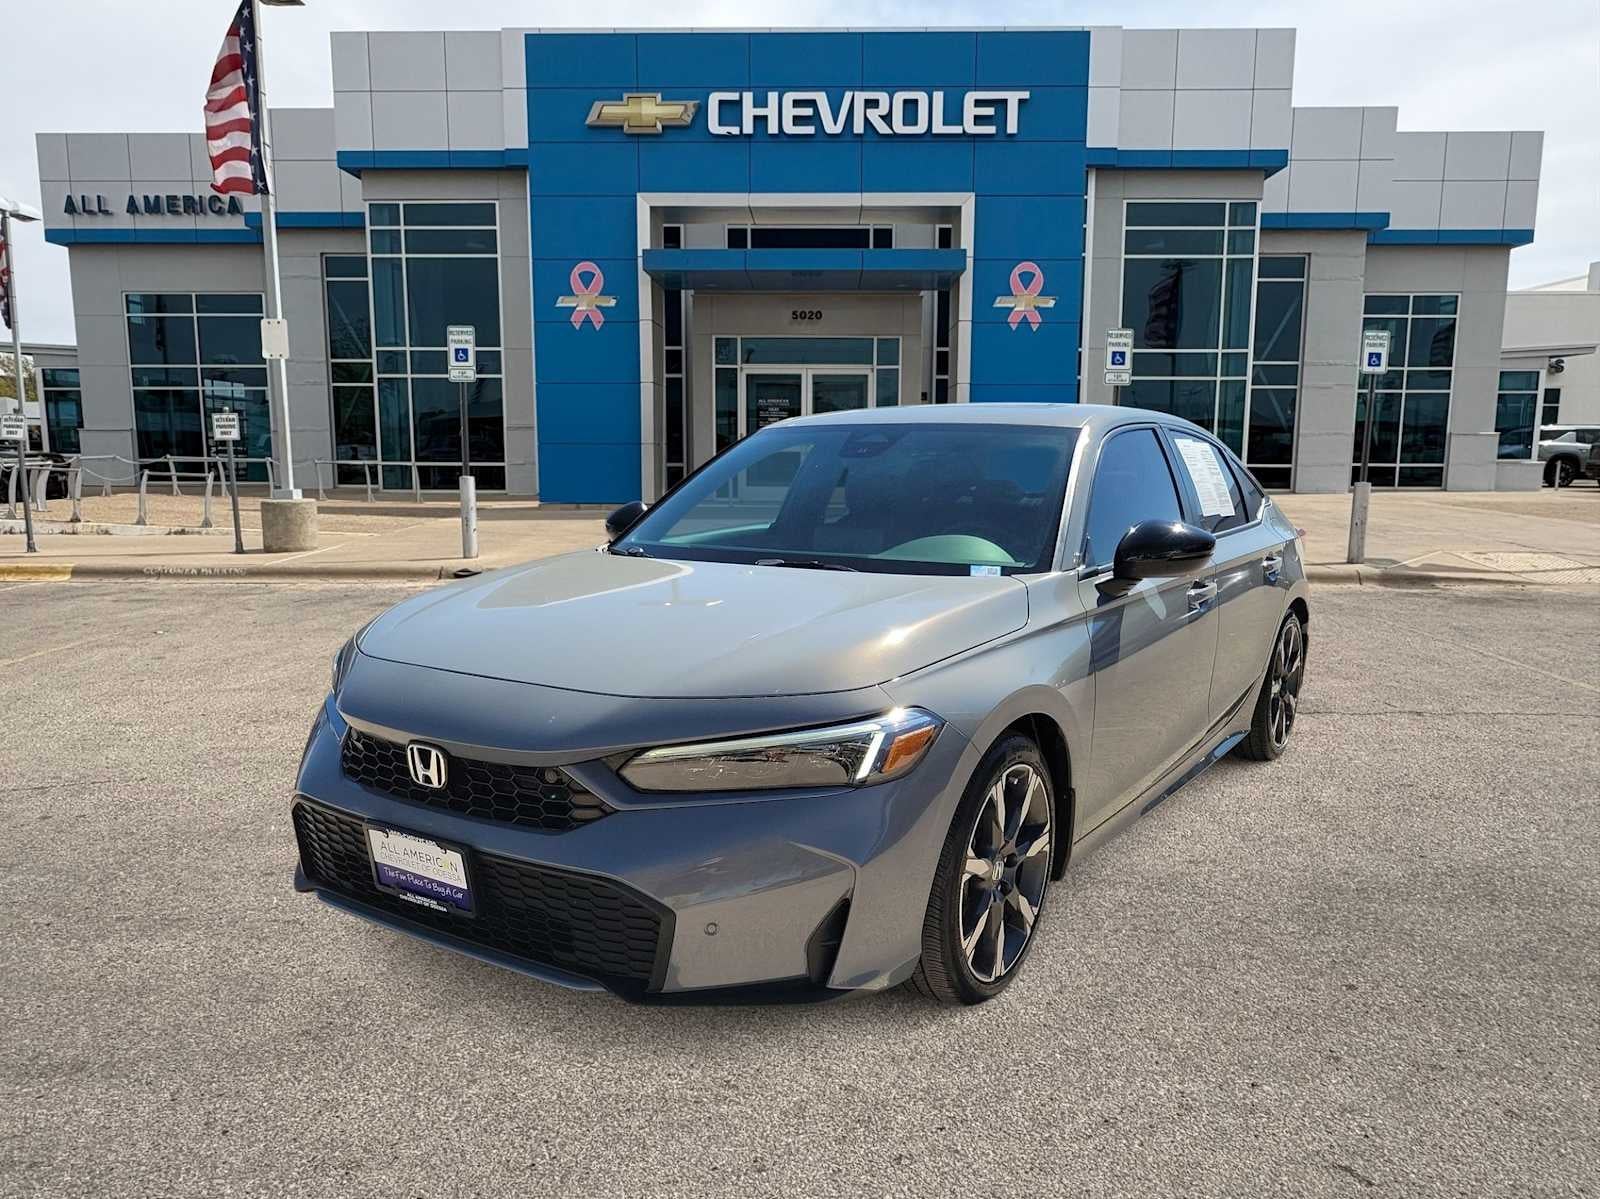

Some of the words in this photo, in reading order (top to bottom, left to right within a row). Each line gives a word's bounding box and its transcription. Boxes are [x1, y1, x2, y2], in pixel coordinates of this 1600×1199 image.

[707, 91, 1030, 135] CHEVROLET
[64, 195, 112, 215] ALL
[126, 195, 242, 215] AMERICA
[792, 310, 822, 320] 5020
[381, 841, 401, 855] ALL
[407, 873, 423, 886] Place
[432, 883, 446, 896] Buy
[452, 889, 464, 899] Car
